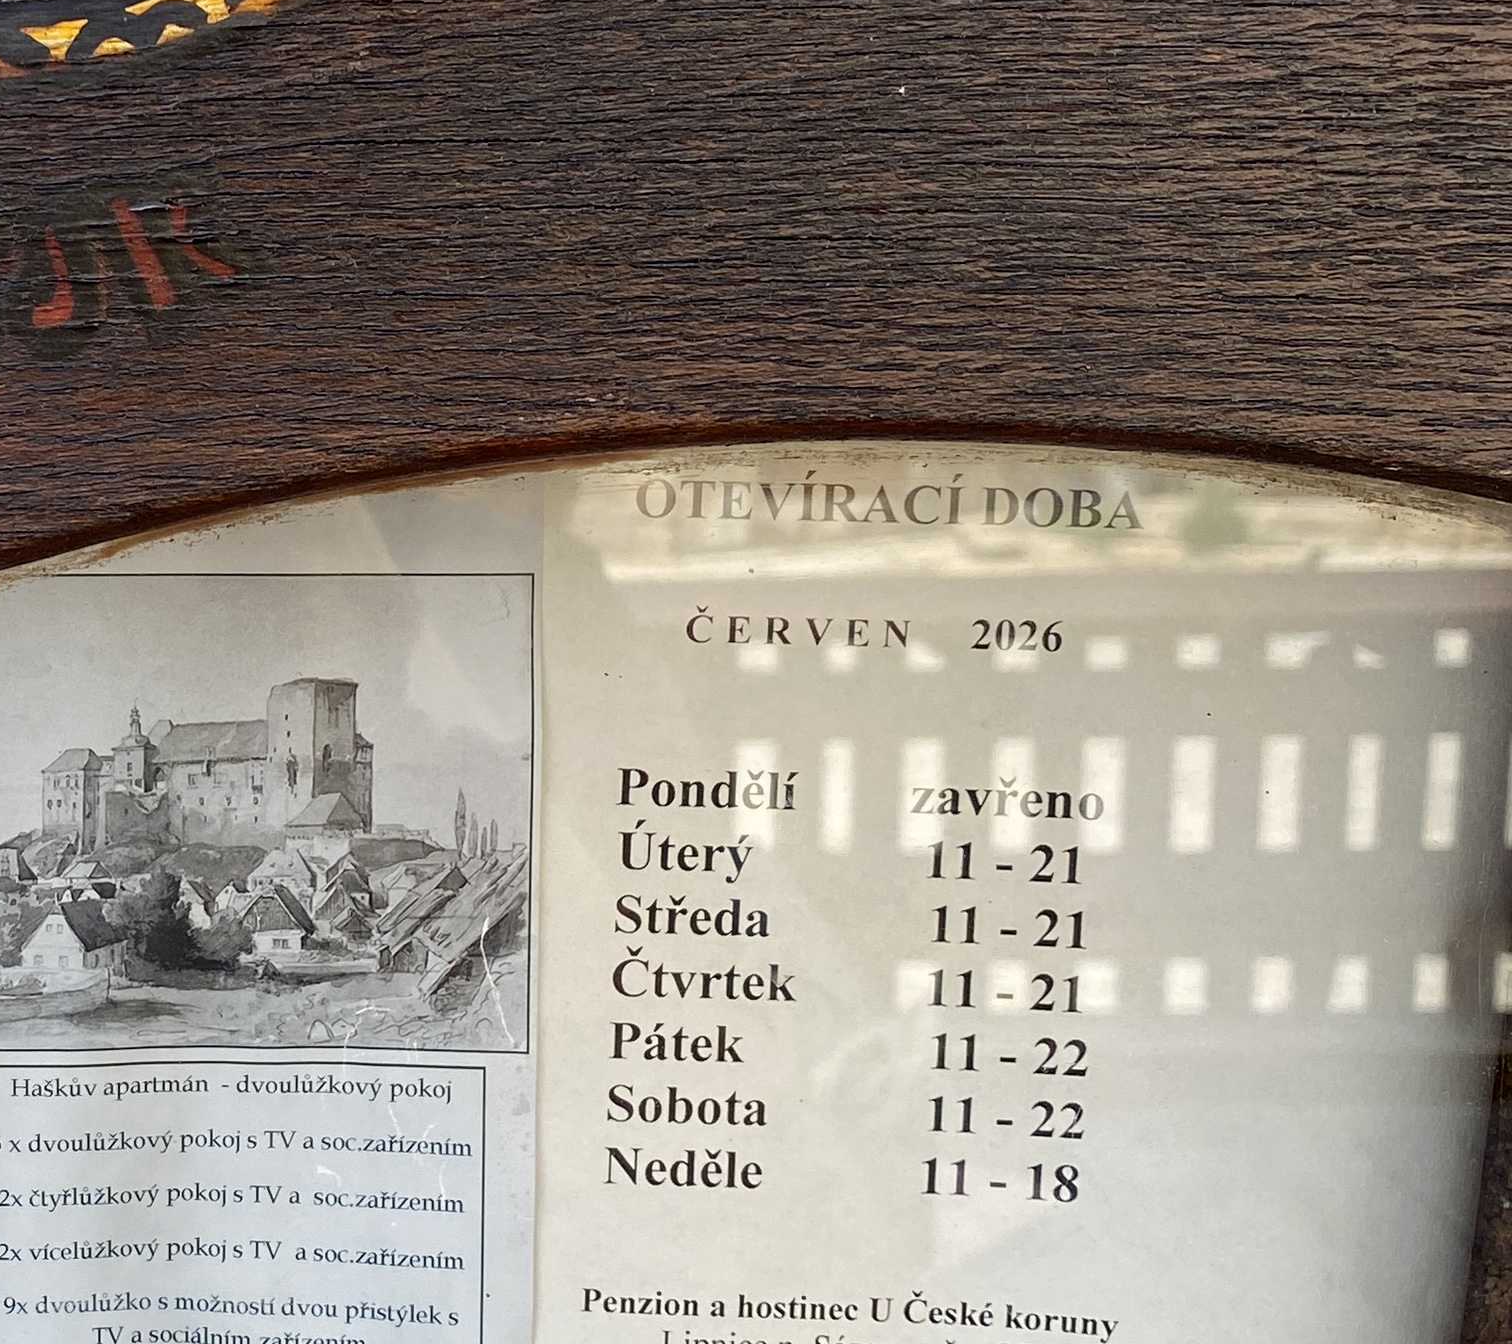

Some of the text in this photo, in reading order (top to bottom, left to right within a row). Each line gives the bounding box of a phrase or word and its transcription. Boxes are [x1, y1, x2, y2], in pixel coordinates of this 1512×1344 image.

[635, 471, 1144, 531] OTEVÍRACÍ DOBA
[686, 606, 1064, 653] ČERVEN 2026
[617, 768, 1105, 821] Pondělí zavřeno
[620, 820, 754, 883] Úterý
[925, 842, 974, 881] 11
[1029, 845, 1083, 885] 21
[614, 896, 770, 938] Středa
[930, 905, 979, 944] 11
[1033, 910, 1088, 950] 21
[612, 947, 798, 1003] Čtvrtek
[926, 971, 975, 1008] 11
[1029, 975, 1083, 1014] 21
[611, 1023, 744, 1064] Pátek
[930, 1034, 979, 1071] 11
[1033, 1039, 1089, 1078] 22
[10, 1076, 98, 1098] Haškův
[103, 1075, 209, 1097] apartmán
[236, 1072, 382, 1101] dvoulůžkový
[389, 1078, 453, 1104] pokoj
[606, 1086, 768, 1127] Sobota
[926, 1096, 975, 1134] 11
[1029, 1101, 1085, 1140] 22
[604, 1147, 763, 1190] Neděle
[920, 1160, 969, 1197] 11
[1025, 1163, 1079, 1204] 18
[582, 1287, 1120, 1344] Penzion a hostinec U České koruny
